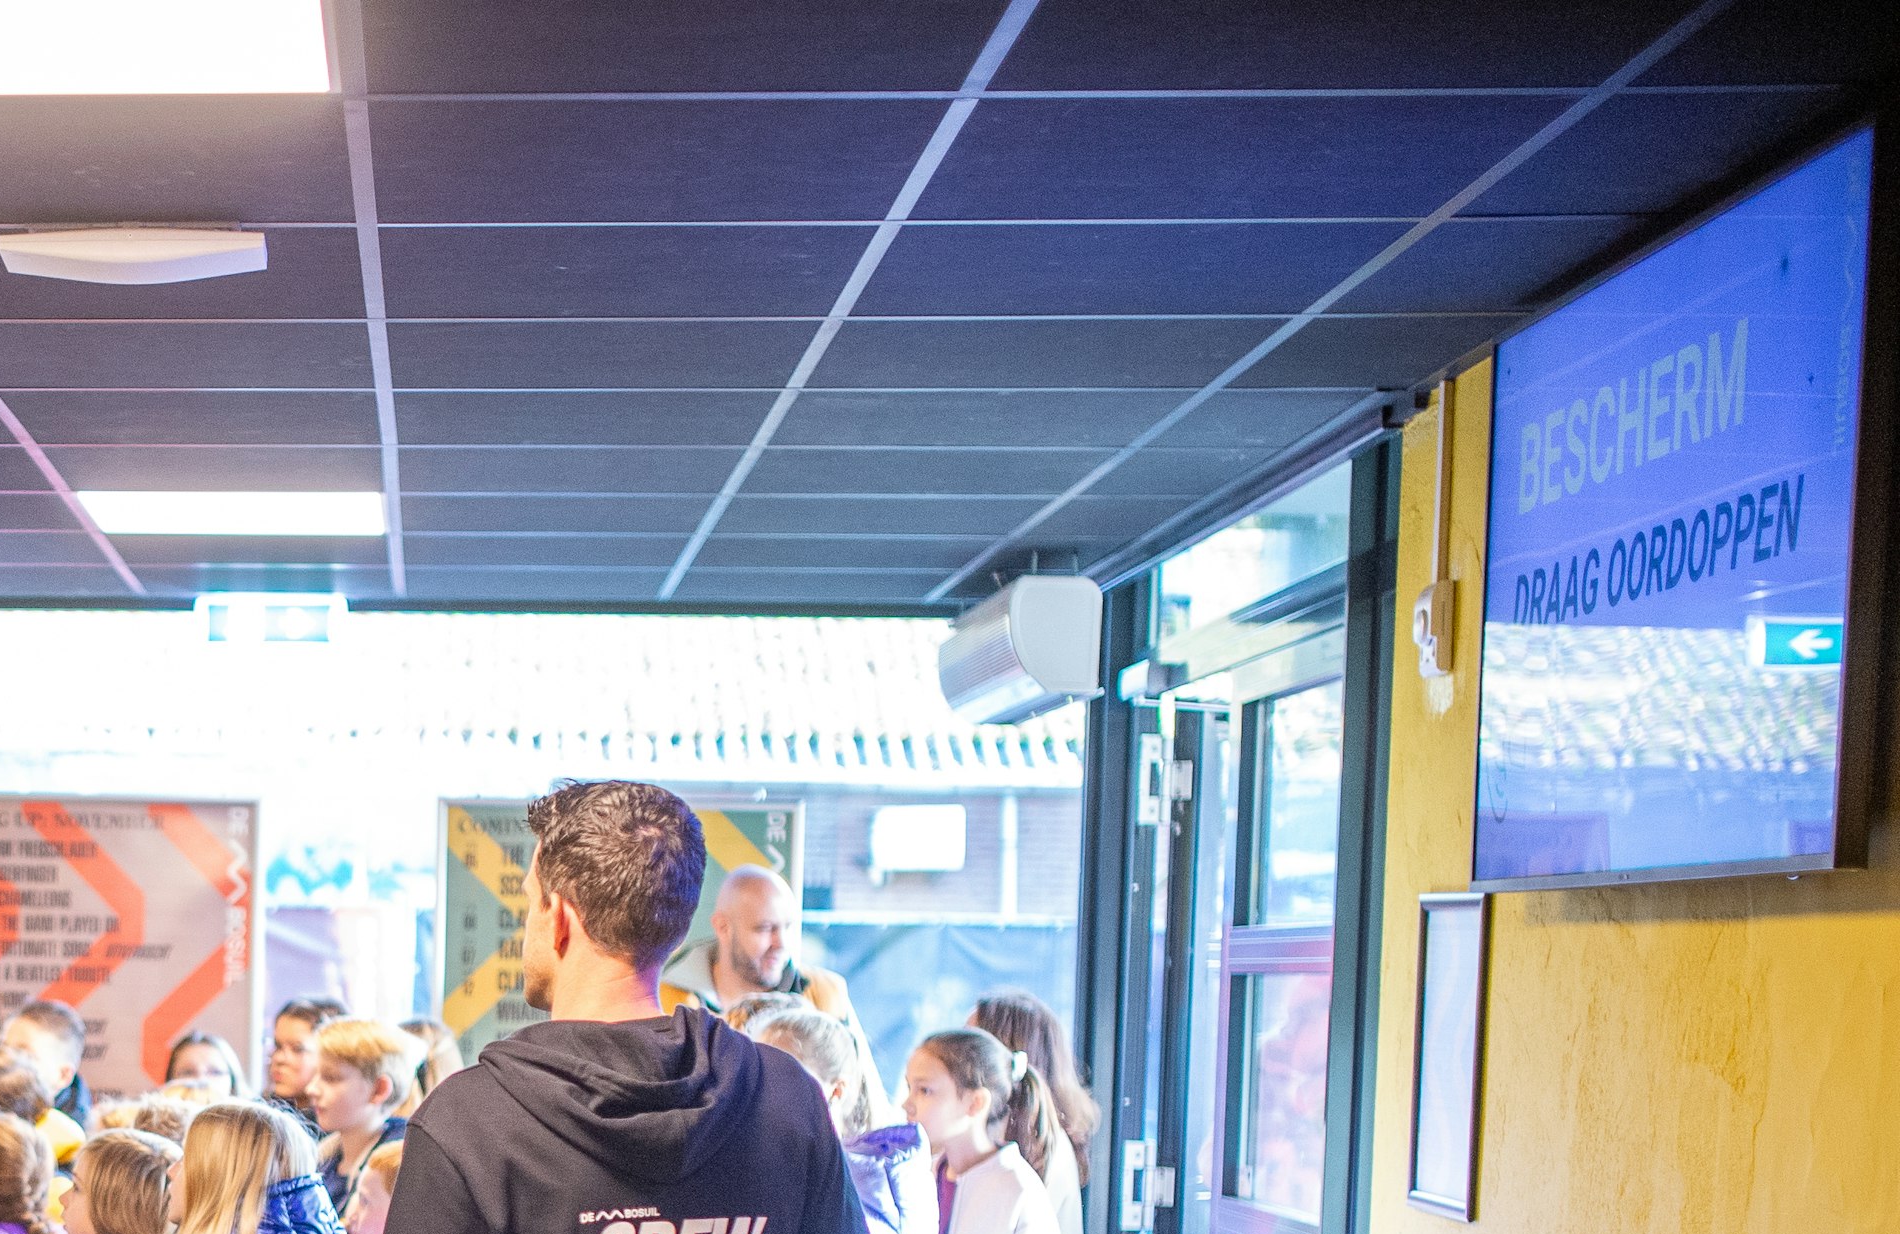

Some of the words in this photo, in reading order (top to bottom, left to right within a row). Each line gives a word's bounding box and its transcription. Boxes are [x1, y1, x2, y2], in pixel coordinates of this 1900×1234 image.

[1518, 317, 1749, 515] BESCHERM
[1513, 546, 1601, 626] DRAAG
[1607, 473, 1805, 608] OORDOPPEN
[767, 811, 787, 843] DE
[579, 1211, 596, 1224] DE
[623, 1206, 661, 1219] BOSUIL
